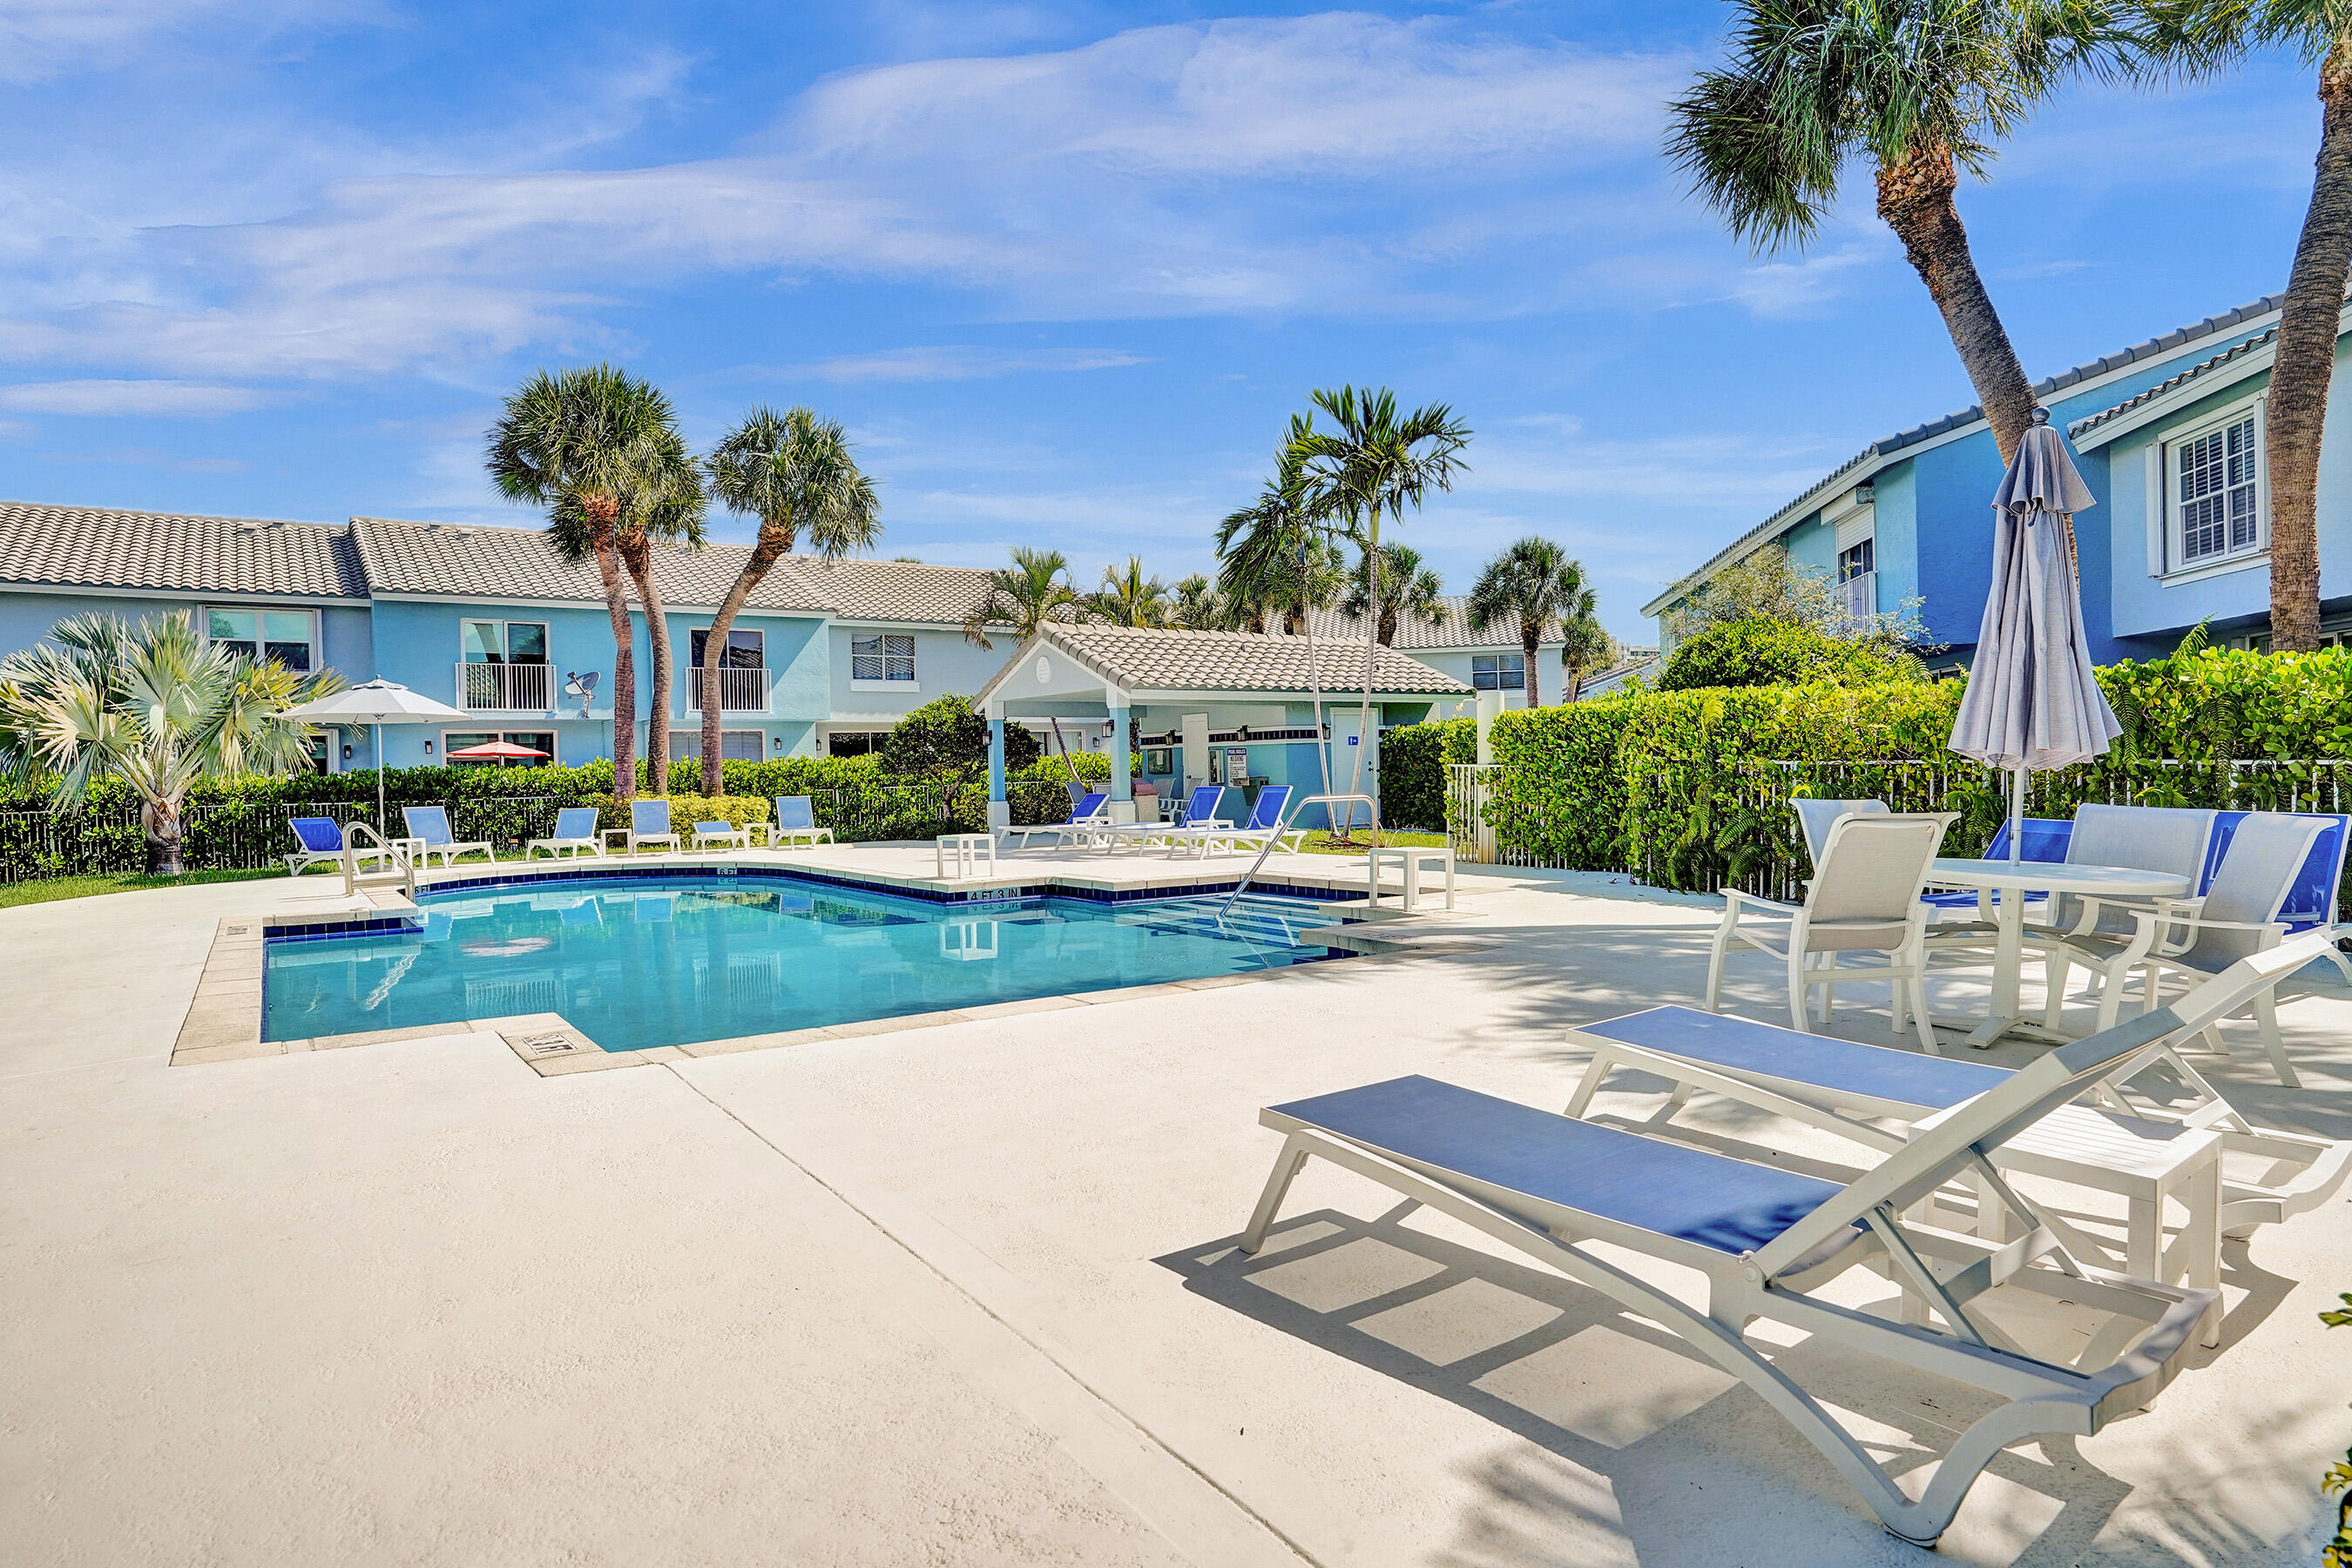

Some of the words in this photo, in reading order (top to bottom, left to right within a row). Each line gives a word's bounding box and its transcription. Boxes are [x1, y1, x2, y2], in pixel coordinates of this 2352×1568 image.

[414, 886, 419, 895] 6
[421, 884, 429, 893] FT
[970, 891, 978, 901] 4
[982, 890, 993, 900] FT
[997, 889, 1004, 899] 3
[1008, 888, 1017, 898] IN
